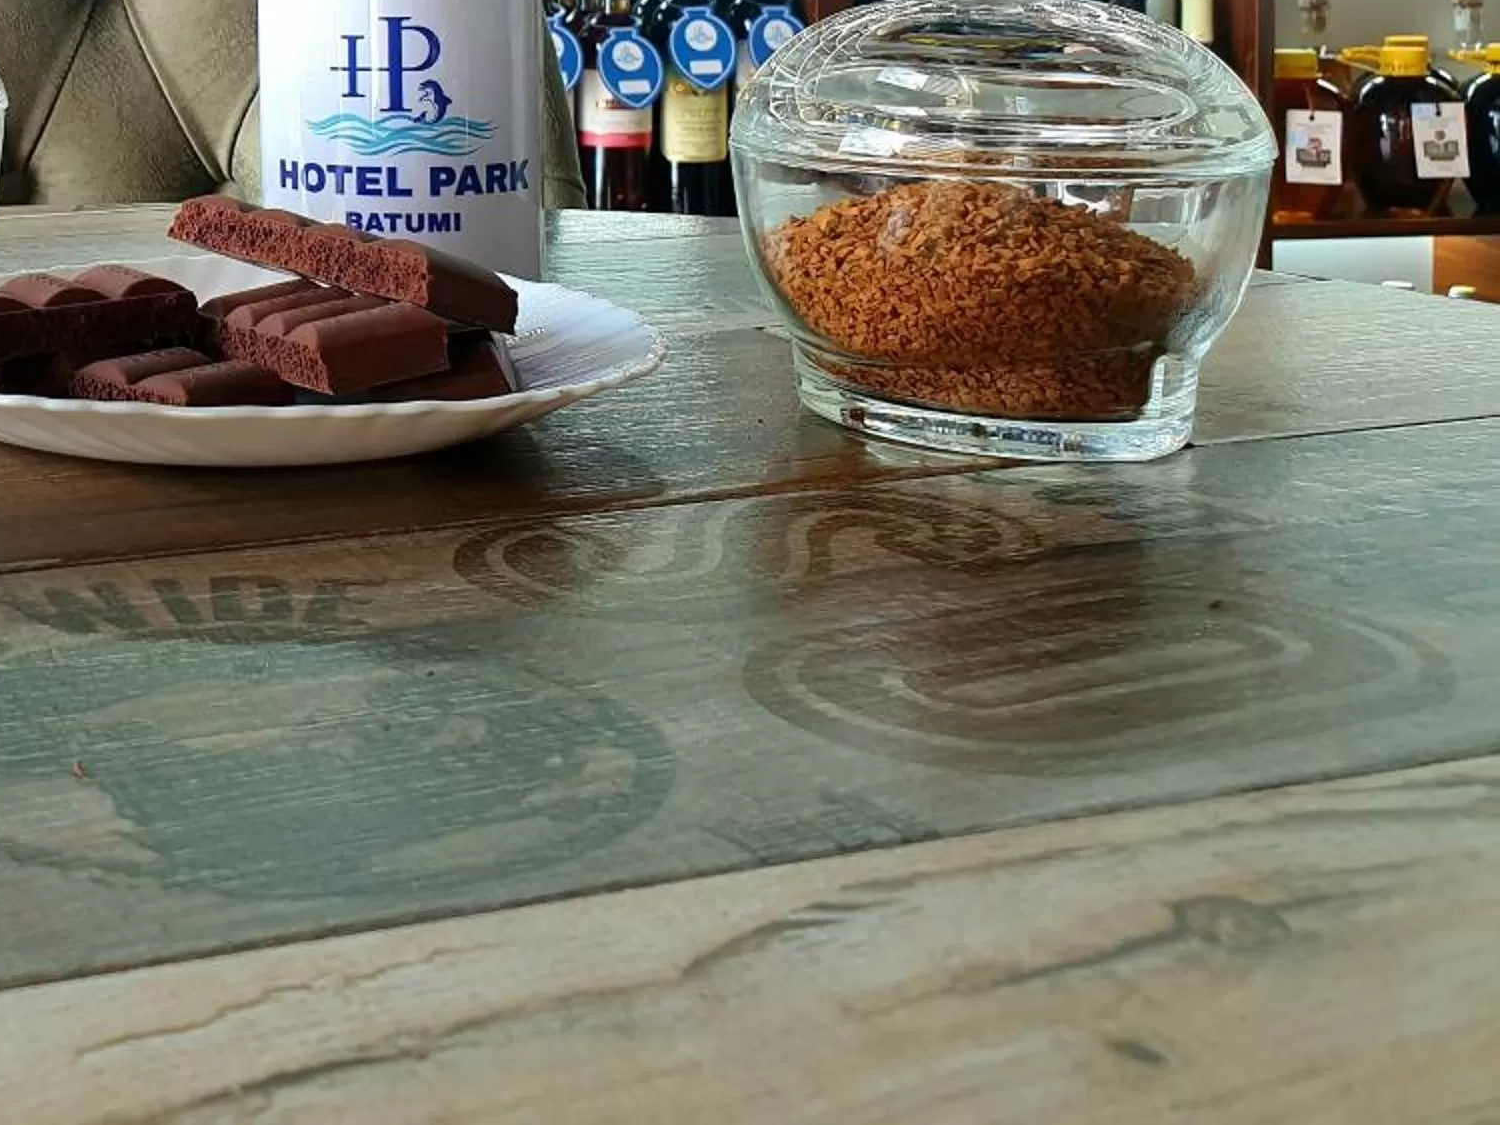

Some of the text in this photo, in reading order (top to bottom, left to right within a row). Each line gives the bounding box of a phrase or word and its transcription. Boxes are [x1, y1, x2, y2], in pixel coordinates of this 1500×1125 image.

[279, 158, 530, 197] HOTEL PARK
[345, 211, 462, 233] BATUMI
